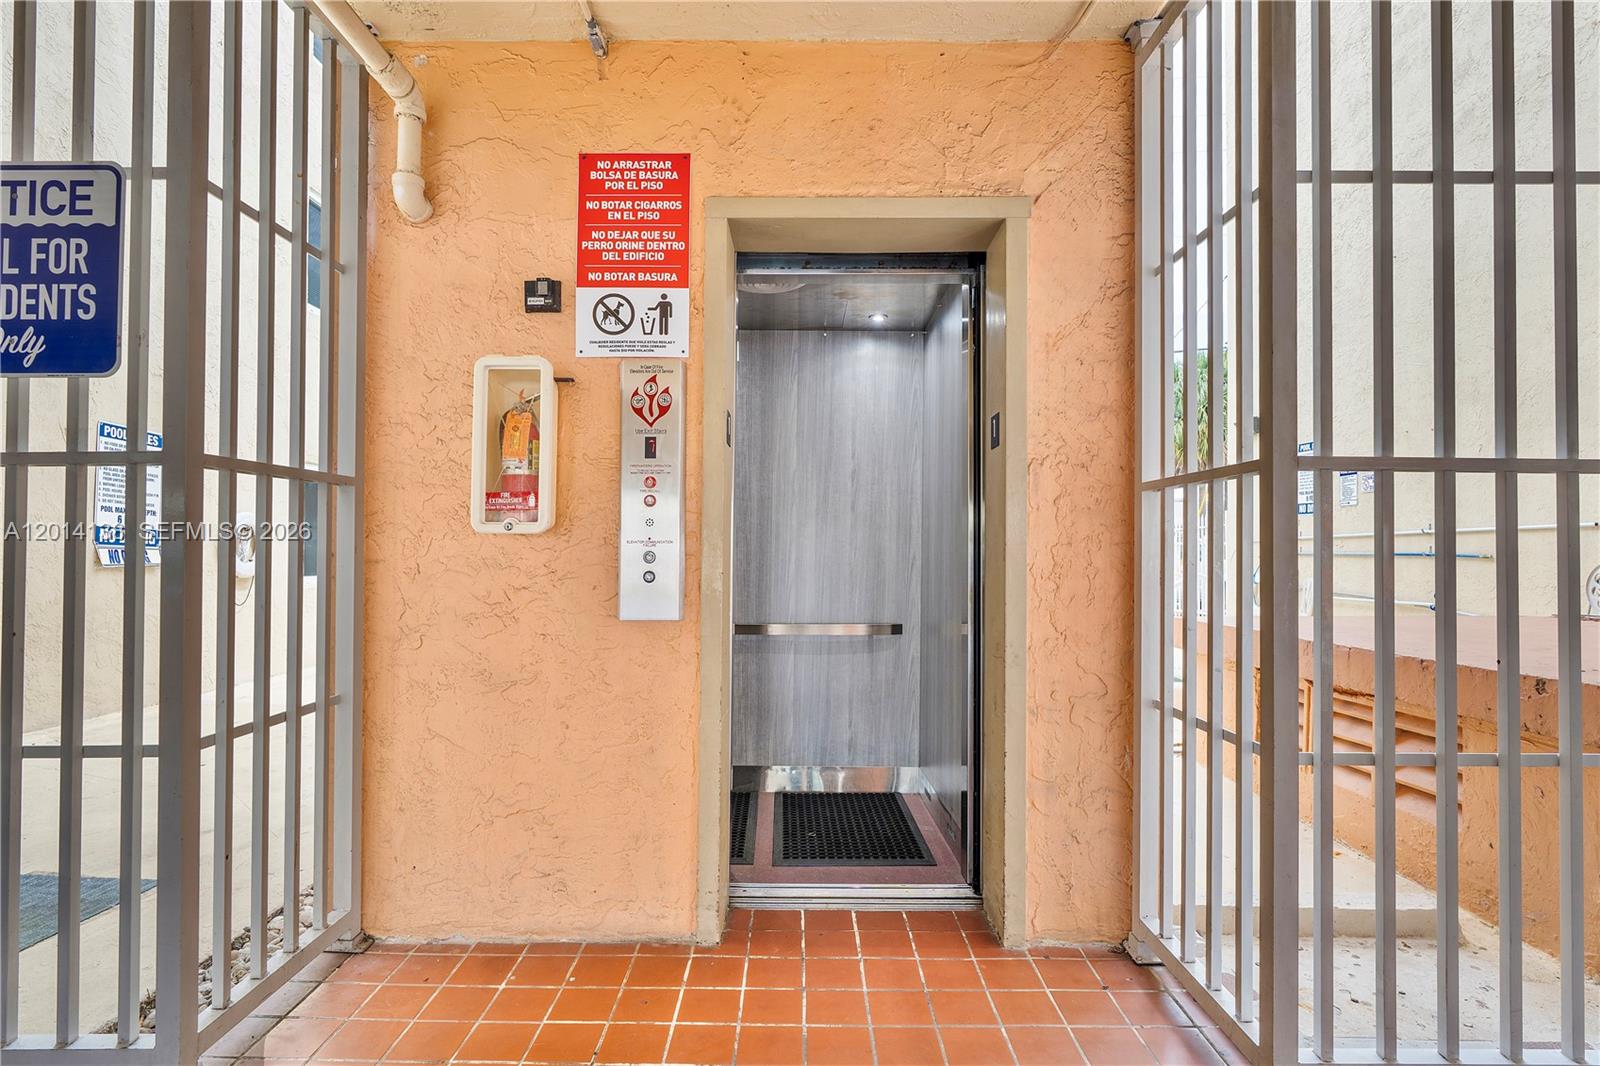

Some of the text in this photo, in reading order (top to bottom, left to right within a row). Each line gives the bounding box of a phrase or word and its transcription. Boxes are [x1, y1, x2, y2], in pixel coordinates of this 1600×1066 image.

[597, 161, 672, 169] NO ARRASTRAR
[590, 171, 678, 180] BOLSA DE BASURA
[605, 182, 663, 190] POR EL PISO
[586, 201, 682, 209] NO BOTAR CIGARROS
[608, 212, 660, 220] EN EL PISO
[592, 231, 675, 239] NO DEJAR QUE SU
[582, 242, 685, 250] PERRO ORINE DENTRO
[30, 238, 88, 274] FOR
[602, 252, 664, 260] DEL EDIFICIO
[588, 272, 678, 281] NO BOTAR BASURA
[108, 549, 121, 563] NO
